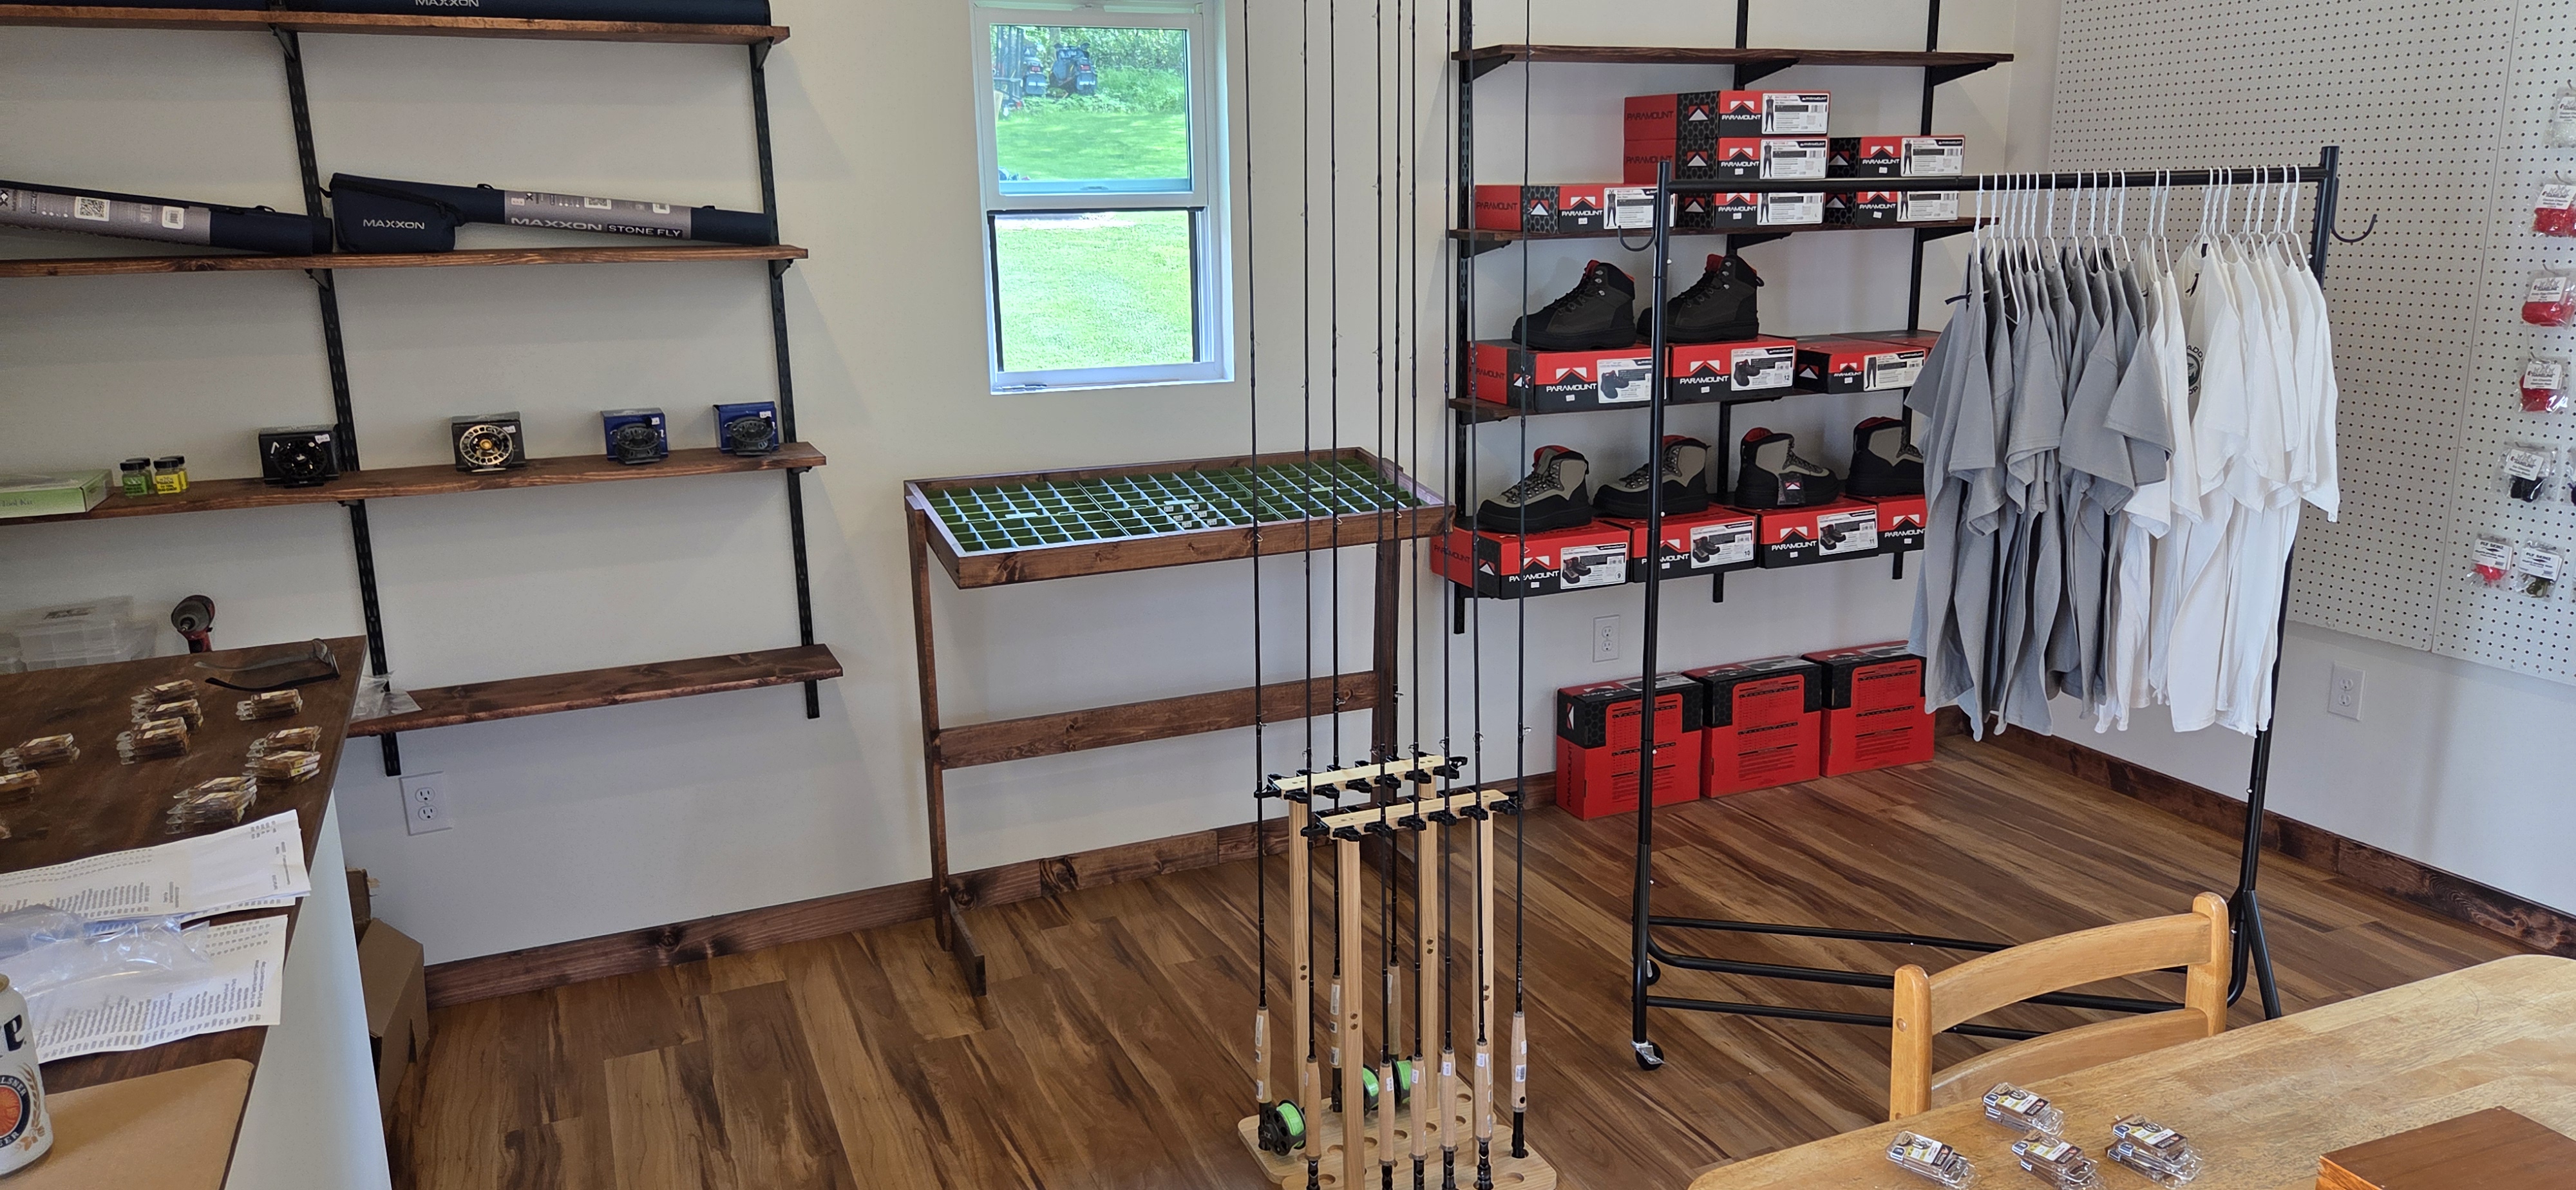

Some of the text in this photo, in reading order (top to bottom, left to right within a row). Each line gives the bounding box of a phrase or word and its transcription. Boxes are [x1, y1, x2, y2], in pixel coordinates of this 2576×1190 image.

[1626, 111, 1674, 120] PARAMOUNT
[1476, 202, 1518, 211] PARAMOUNT
[363, 219, 425, 230] MAXXON
[511, 217, 681, 237] MAXXON STONE FLY
[2187, 345, 2203, 362] ADD
[1469, 366, 1505, 379] PRAMOUNT
[1680, 375, 1729, 384] PARAMOUNT
[1546, 383, 1597, 392] PARAMOUNT
[1772, 540, 1817, 551] PARAMOUNT
[1642, 554, 1690, 564] PMOUNT
[1509, 571, 1559, 582] PAAMOUNT
